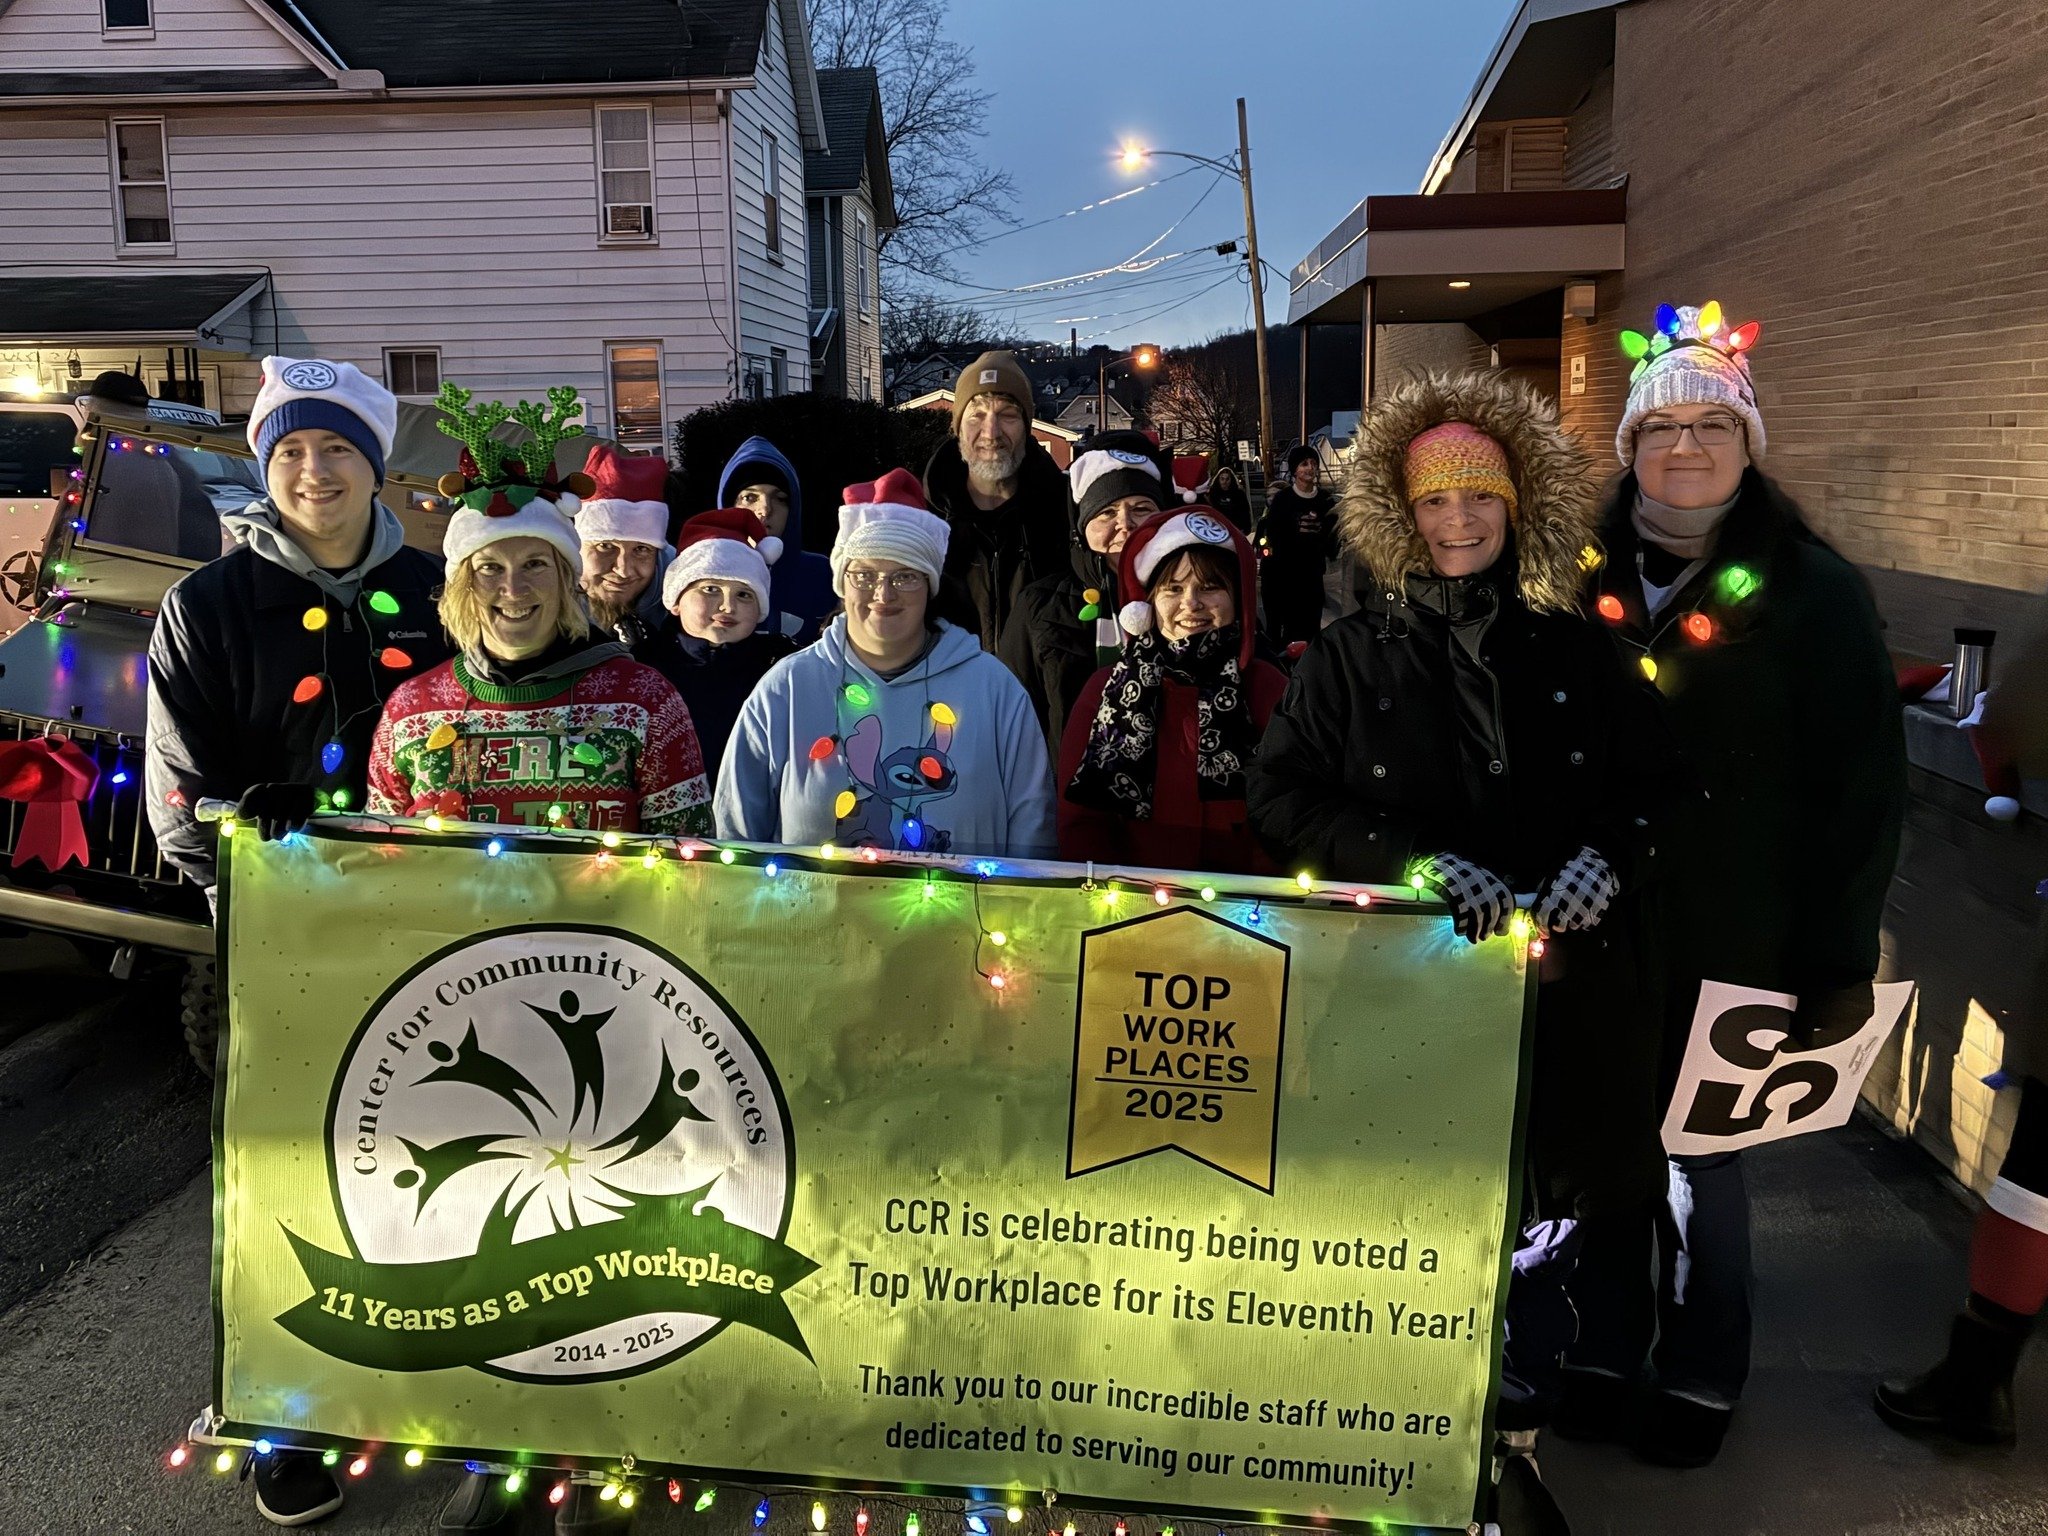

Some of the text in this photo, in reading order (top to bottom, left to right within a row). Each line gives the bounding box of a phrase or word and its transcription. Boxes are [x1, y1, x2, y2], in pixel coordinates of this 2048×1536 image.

[1135, 971, 1230, 1011] TOP
[354, 952, 767, 1175] Center for Community Resources
[1106, 1047, 1249, 1083] PLACES
[1123, 1014, 1236, 1049] WORK
[1125, 1088, 1223, 1122] 2025
[884, 1199, 1438, 1273] CCR is celebrating being voted a
[320, 1247, 774, 1330] 11 Years as a Top Workplace
[848, 1262, 1475, 1340] Top Workplace for its Eleventh Year!
[553, 1342, 607, 1363] 2014
[624, 1322, 674, 1354] 2025
[859, 1364, 1451, 1436] Thank you to our incredible staff who are
[886, 1422, 1414, 1496] dedicated to serving our community!
